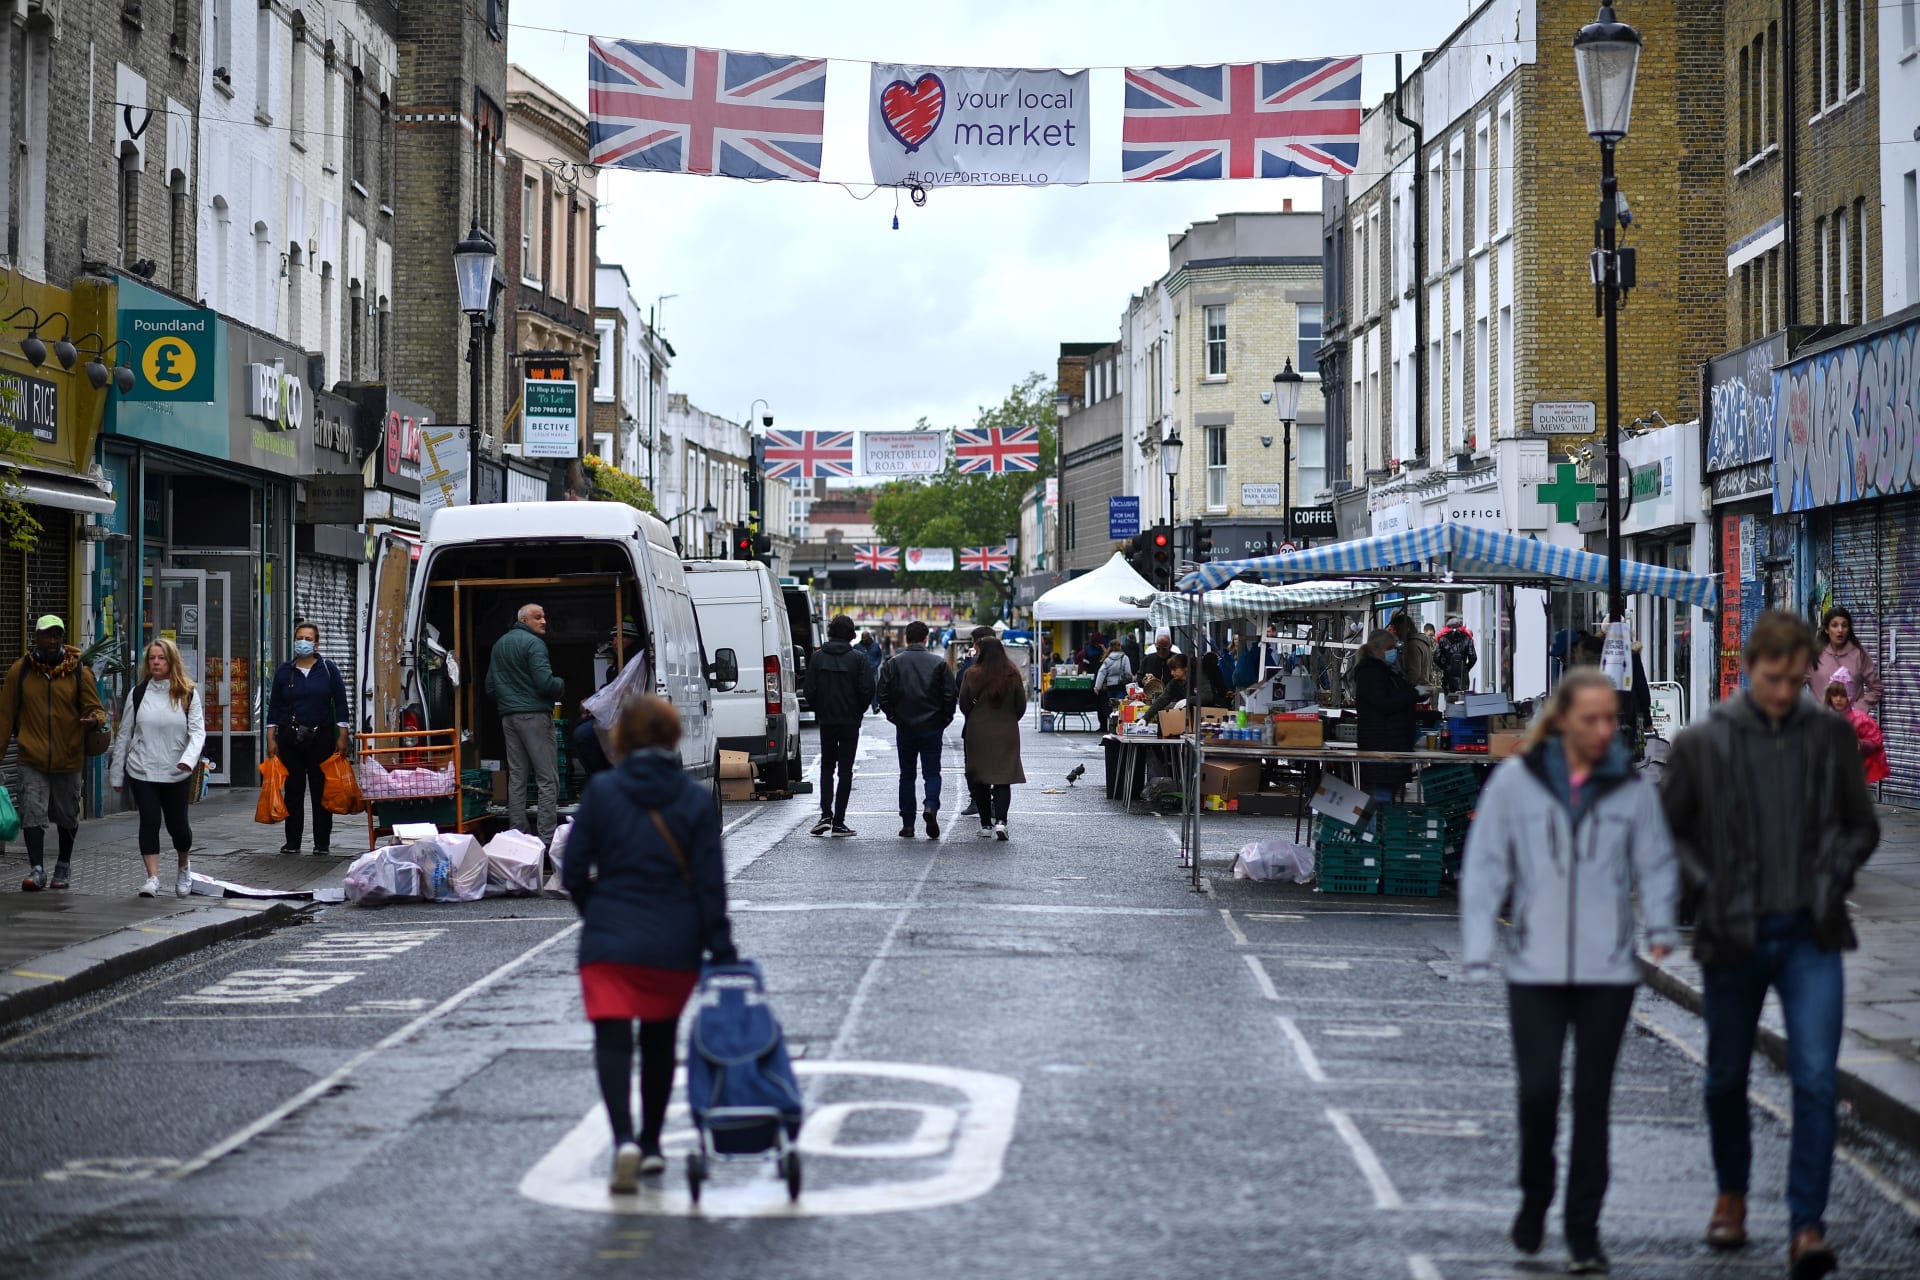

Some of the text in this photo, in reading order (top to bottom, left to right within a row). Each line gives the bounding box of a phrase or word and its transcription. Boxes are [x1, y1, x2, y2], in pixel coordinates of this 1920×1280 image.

[957, 88, 1073, 111] your local
[954, 117, 1076, 146] market
[907, 170, 1048, 183] #LOVEPORTOBELLO
[134, 319, 205, 331] Poundland
[33, 383, 55, 427] RICE
[538, 394, 564, 404] To Let
[1539, 415, 1588, 423] DUNWORTH
[532, 423, 570, 431] BECTIVE
[870, 449, 937, 459] PORTOBELLO
[1295, 511, 1333, 524] COFFEE
[1452, 509, 1501, 519] OFFICE
